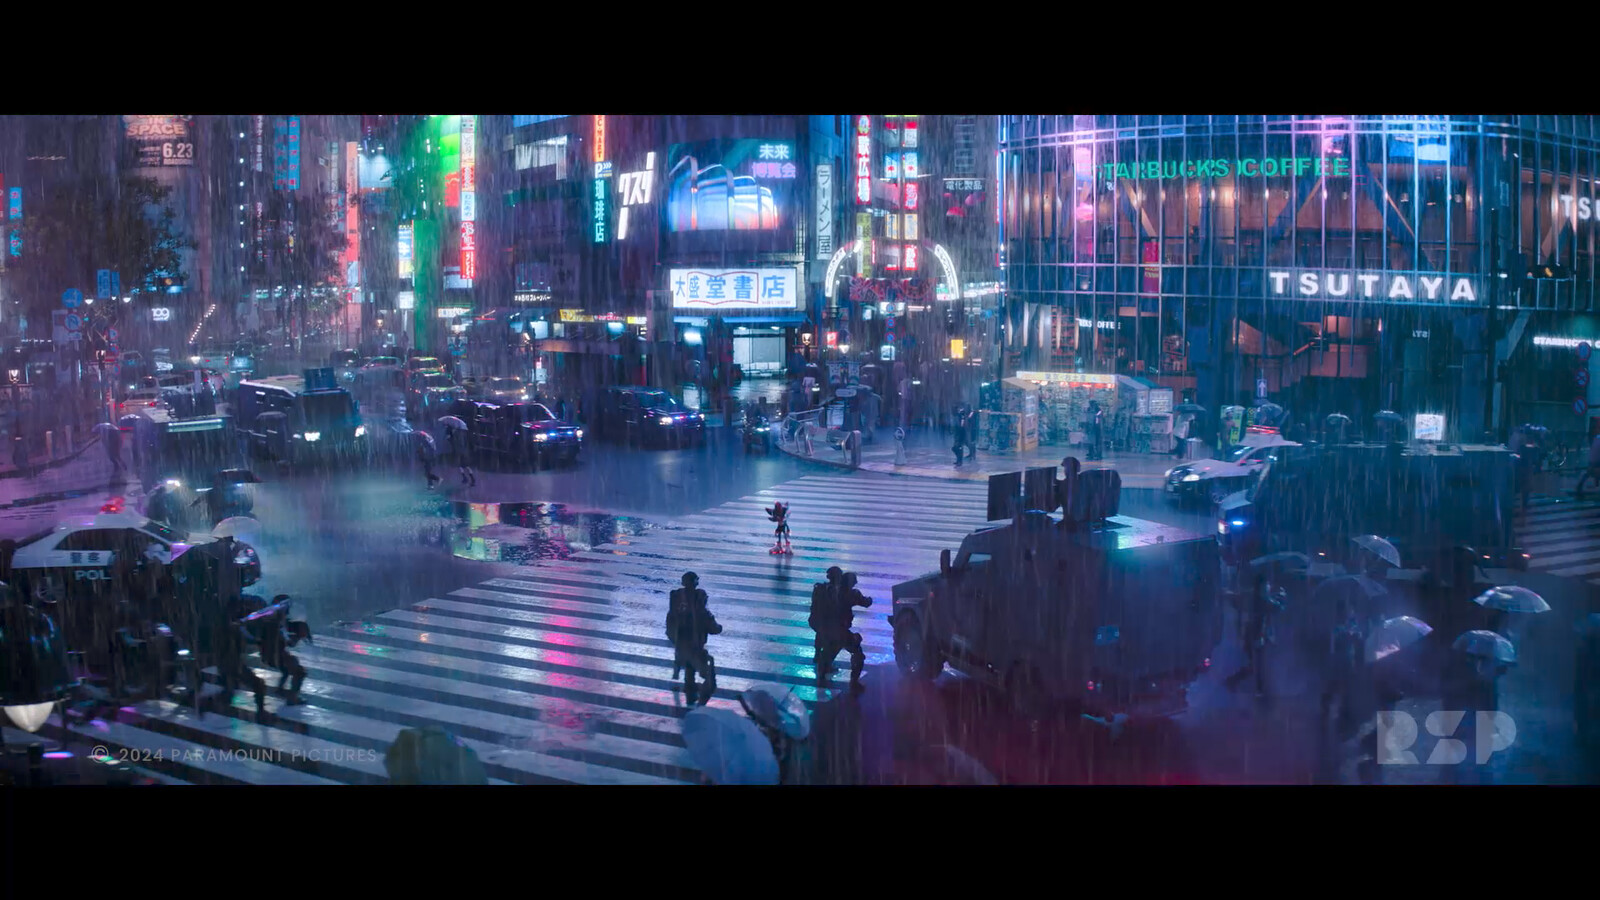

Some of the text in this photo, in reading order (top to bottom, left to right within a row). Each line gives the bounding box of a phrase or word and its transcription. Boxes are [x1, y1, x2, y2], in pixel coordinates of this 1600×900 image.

[127, 124, 185, 136] SPACE
[162, 142, 193, 158] 6.23
[759, 144, 790, 159] 未来
[1099, 157, 1358, 181] TARBUCKS COFFEE
[946, 180, 983, 191] 電化製品
[595, 179, 605, 242] 珈琲店
[819, 170, 831, 255] ラーメン屋
[675, 275, 786, 300] 大盛堂書店
[1270, 272, 1475, 301] TSUTAYA
[151, 307, 170, 321] 109
